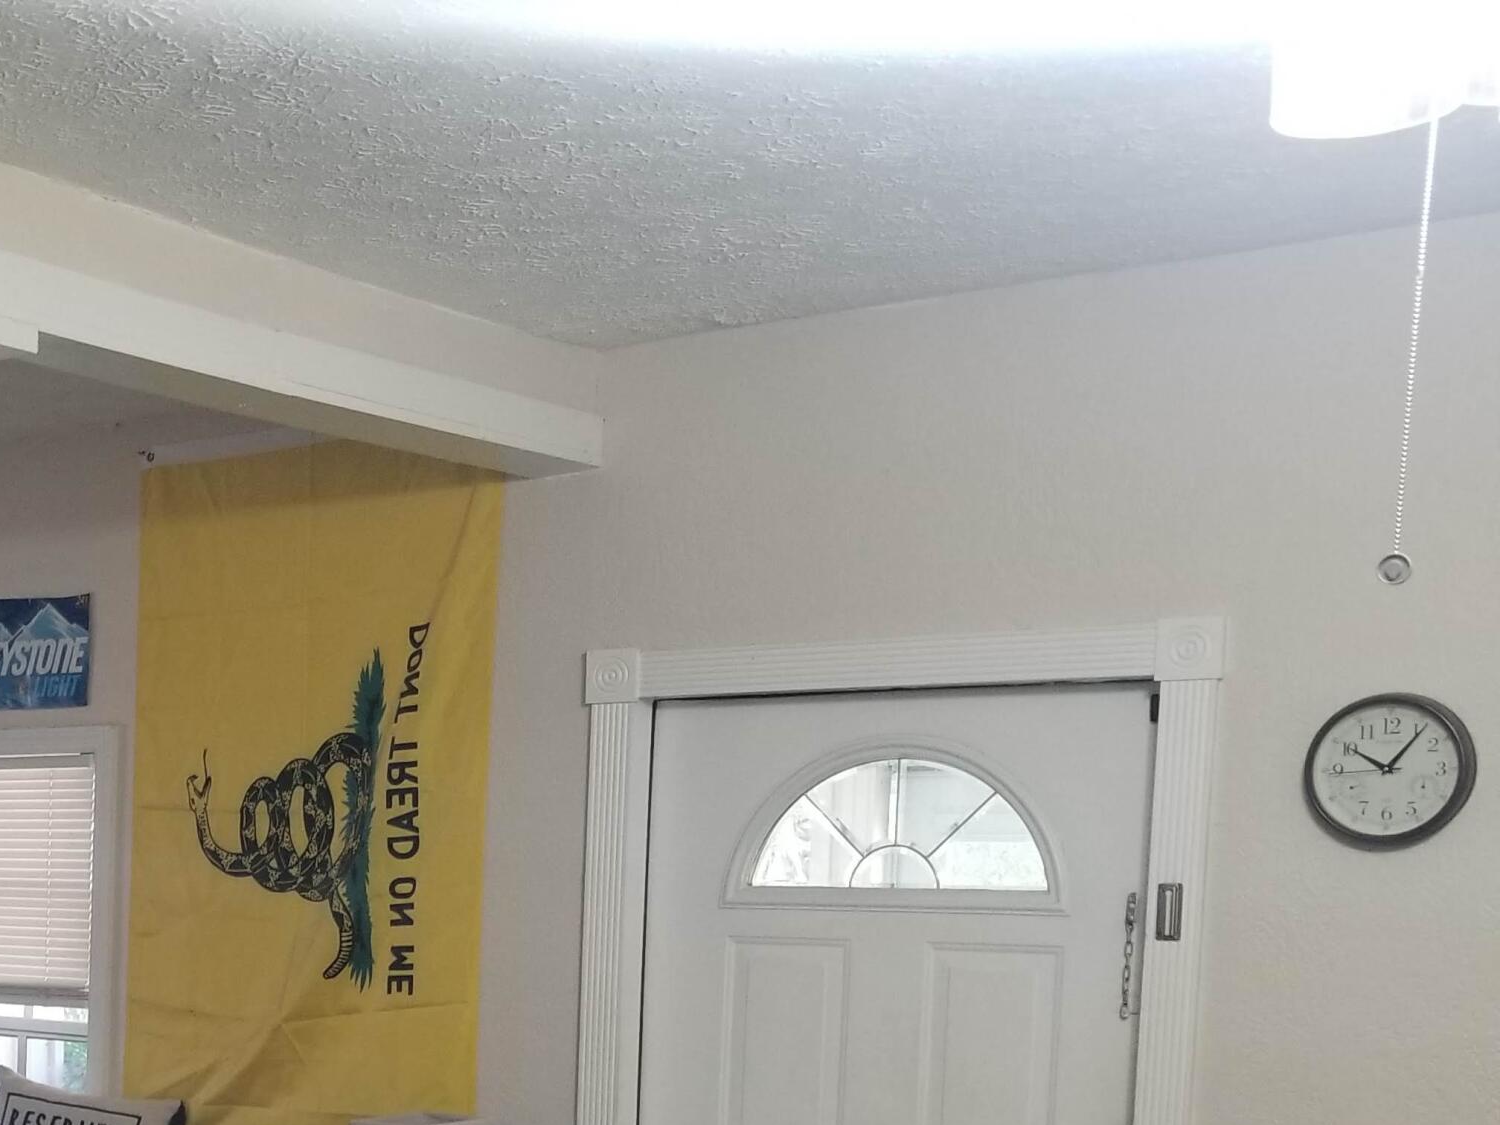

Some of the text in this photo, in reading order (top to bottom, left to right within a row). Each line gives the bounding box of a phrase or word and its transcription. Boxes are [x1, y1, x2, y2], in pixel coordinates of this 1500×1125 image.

[35, 676, 81, 697] LIGHT
[1360, 724, 1374, 740] 11
[1384, 717, 1401, 735] 12
[1427, 737, 1439, 752] 2
[1332, 763, 1344, 775] 9
[1435, 761, 1447, 776] 3
[1358, 801, 1369, 815] 7
[1381, 808, 1392, 821] 6
[1405, 801, 1417, 816] 5
